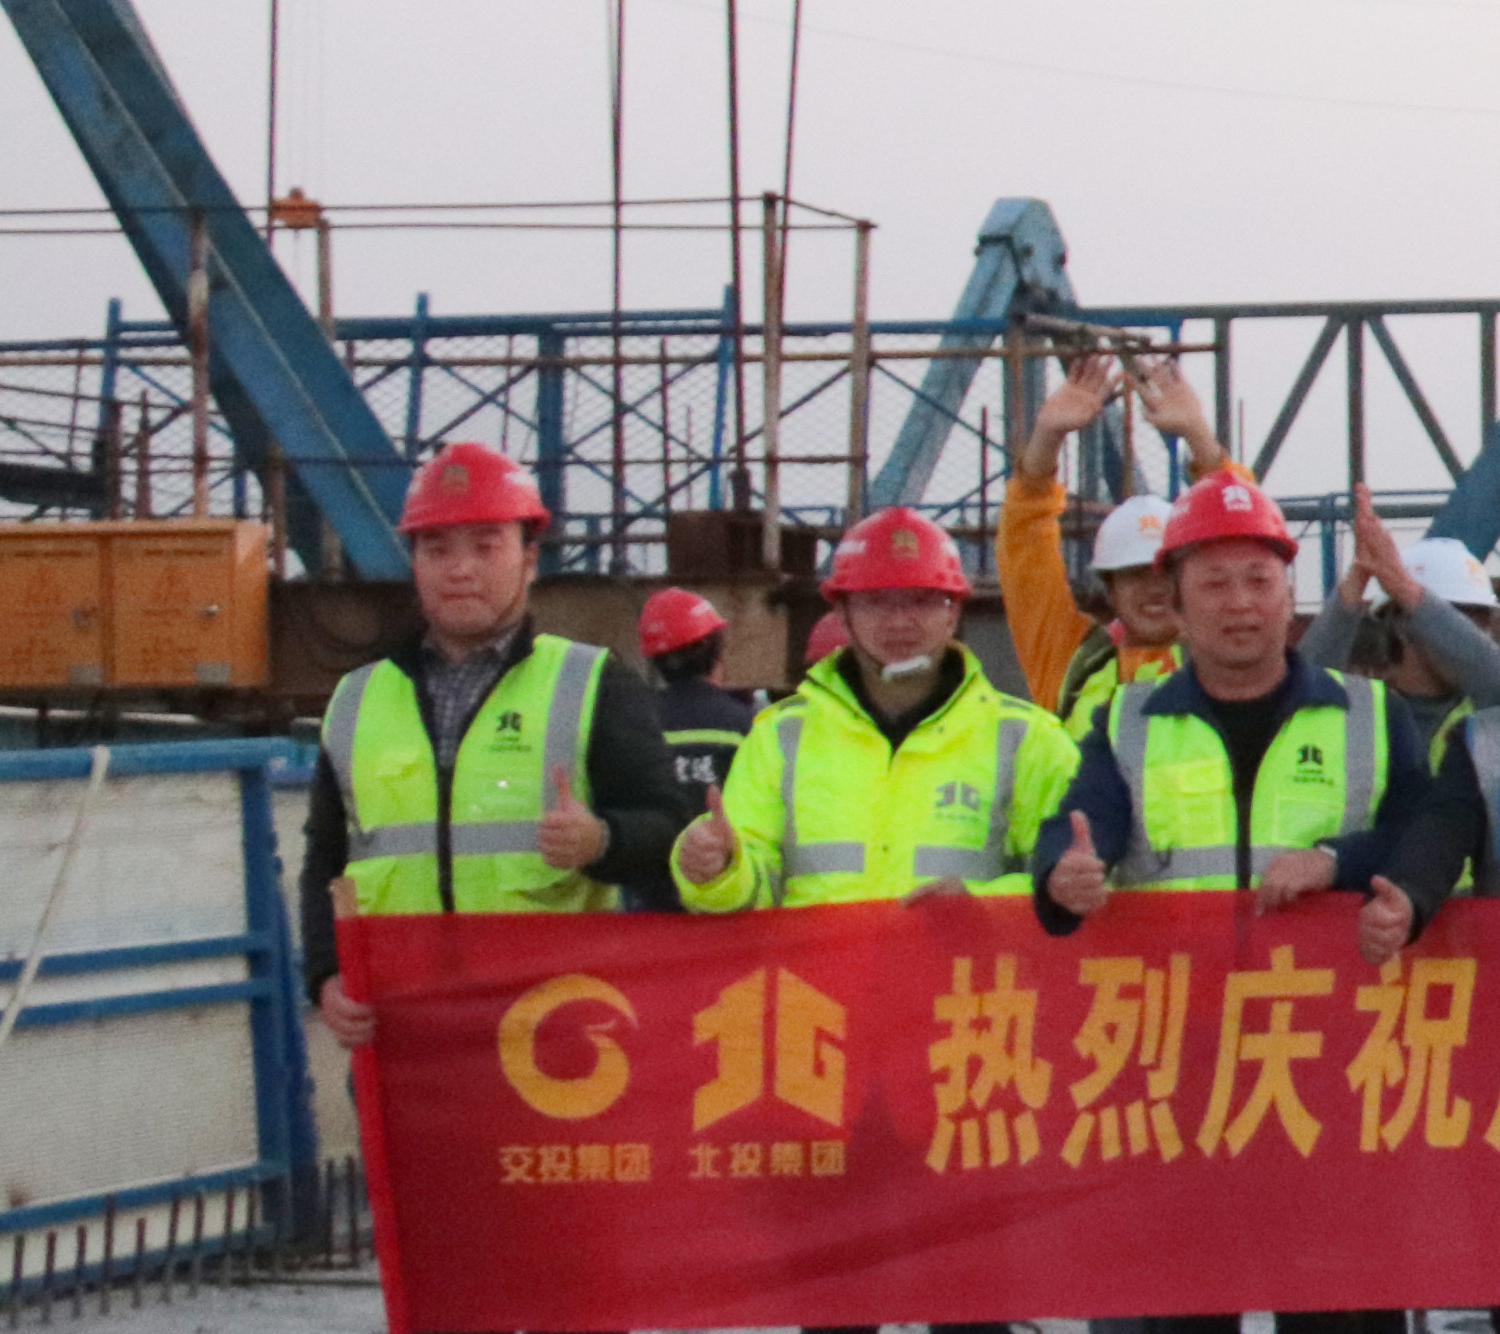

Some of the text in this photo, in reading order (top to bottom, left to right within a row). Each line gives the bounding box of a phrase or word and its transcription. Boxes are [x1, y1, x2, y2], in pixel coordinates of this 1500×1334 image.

[498, 1142, 653, 1185] 交投集团
[688, 1139, 848, 1179] 北投集团
